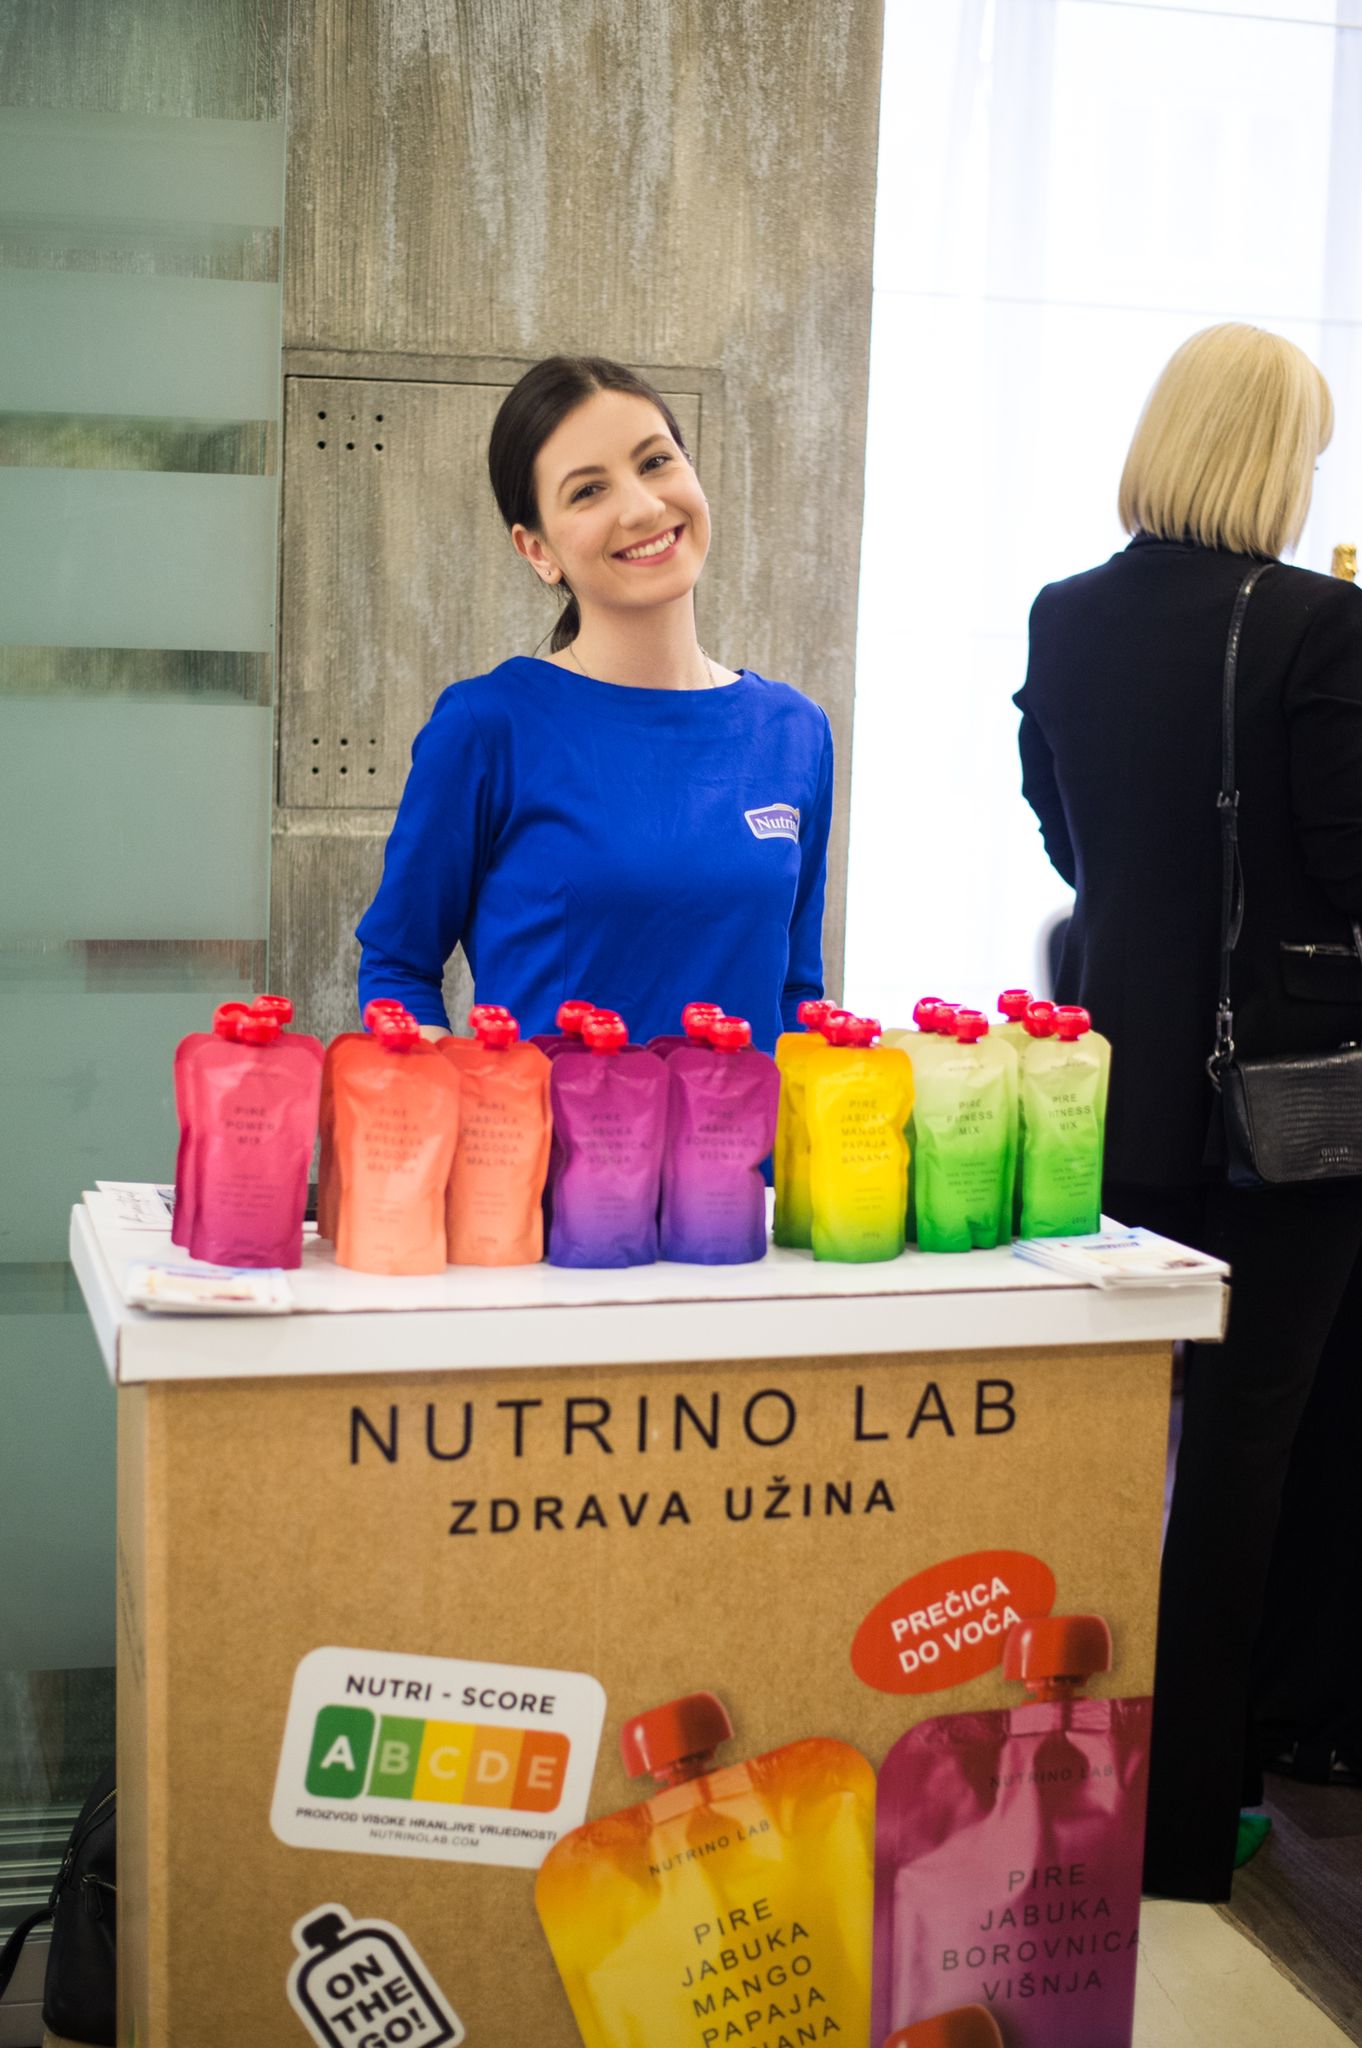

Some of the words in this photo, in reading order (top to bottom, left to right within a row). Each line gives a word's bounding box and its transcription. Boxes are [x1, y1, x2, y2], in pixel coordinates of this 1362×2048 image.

[754, 815, 797, 831] Nutri
[1052, 1093, 1077, 1104] PIRE
[841, 1127, 886, 1137] MANGO
[959, 1126, 981, 1136] MIX
[350, 1388, 797, 1464] NUTRINO
[854, 1379, 1016, 1441] LAB
[448, 1491, 691, 1535] ZDRAVA
[724, 1475, 896, 1521] UŽINA
[890, 1576, 1010, 1643] PREČICA
[899, 1640, 940, 1674] DO
[346, 1675, 432, 1702] NUTRI
[462, 1686, 556, 1715] SCORE
[320, 1735, 355, 1772] A
[379, 1741, 409, 1775] B
[428, 1746, 460, 1780] C
[476, 1750, 510, 1784] D
[526, 1755, 558, 1790] E
[296, 1807, 358, 1823] PROIZVOD
[361, 1813, 406, 1827] VISOKE
[409, 1817, 476, 1834] HRANLJIVE
[479, 1824, 557, 1841] VRIJEDNOSTI
[648, 1835, 730, 1876] NUTRINO
[736, 1819, 770, 1842] LAB
[1008, 1864, 1086, 1892] PIRE
[693, 1898, 773, 1944] PIRE
[980, 1898, 1111, 1931] JABUKA
[326, 1954, 384, 1999] ON
[681, 1922, 809, 1988] JABUKA
[330, 1977, 414, 2033] THE
[692, 1955, 811, 2018] MANGO
[982, 1970, 1102, 2001] VIŠNJA
[358, 2006, 427, 2048] GO!
[702, 1986, 826, 2048] PAPAJA
